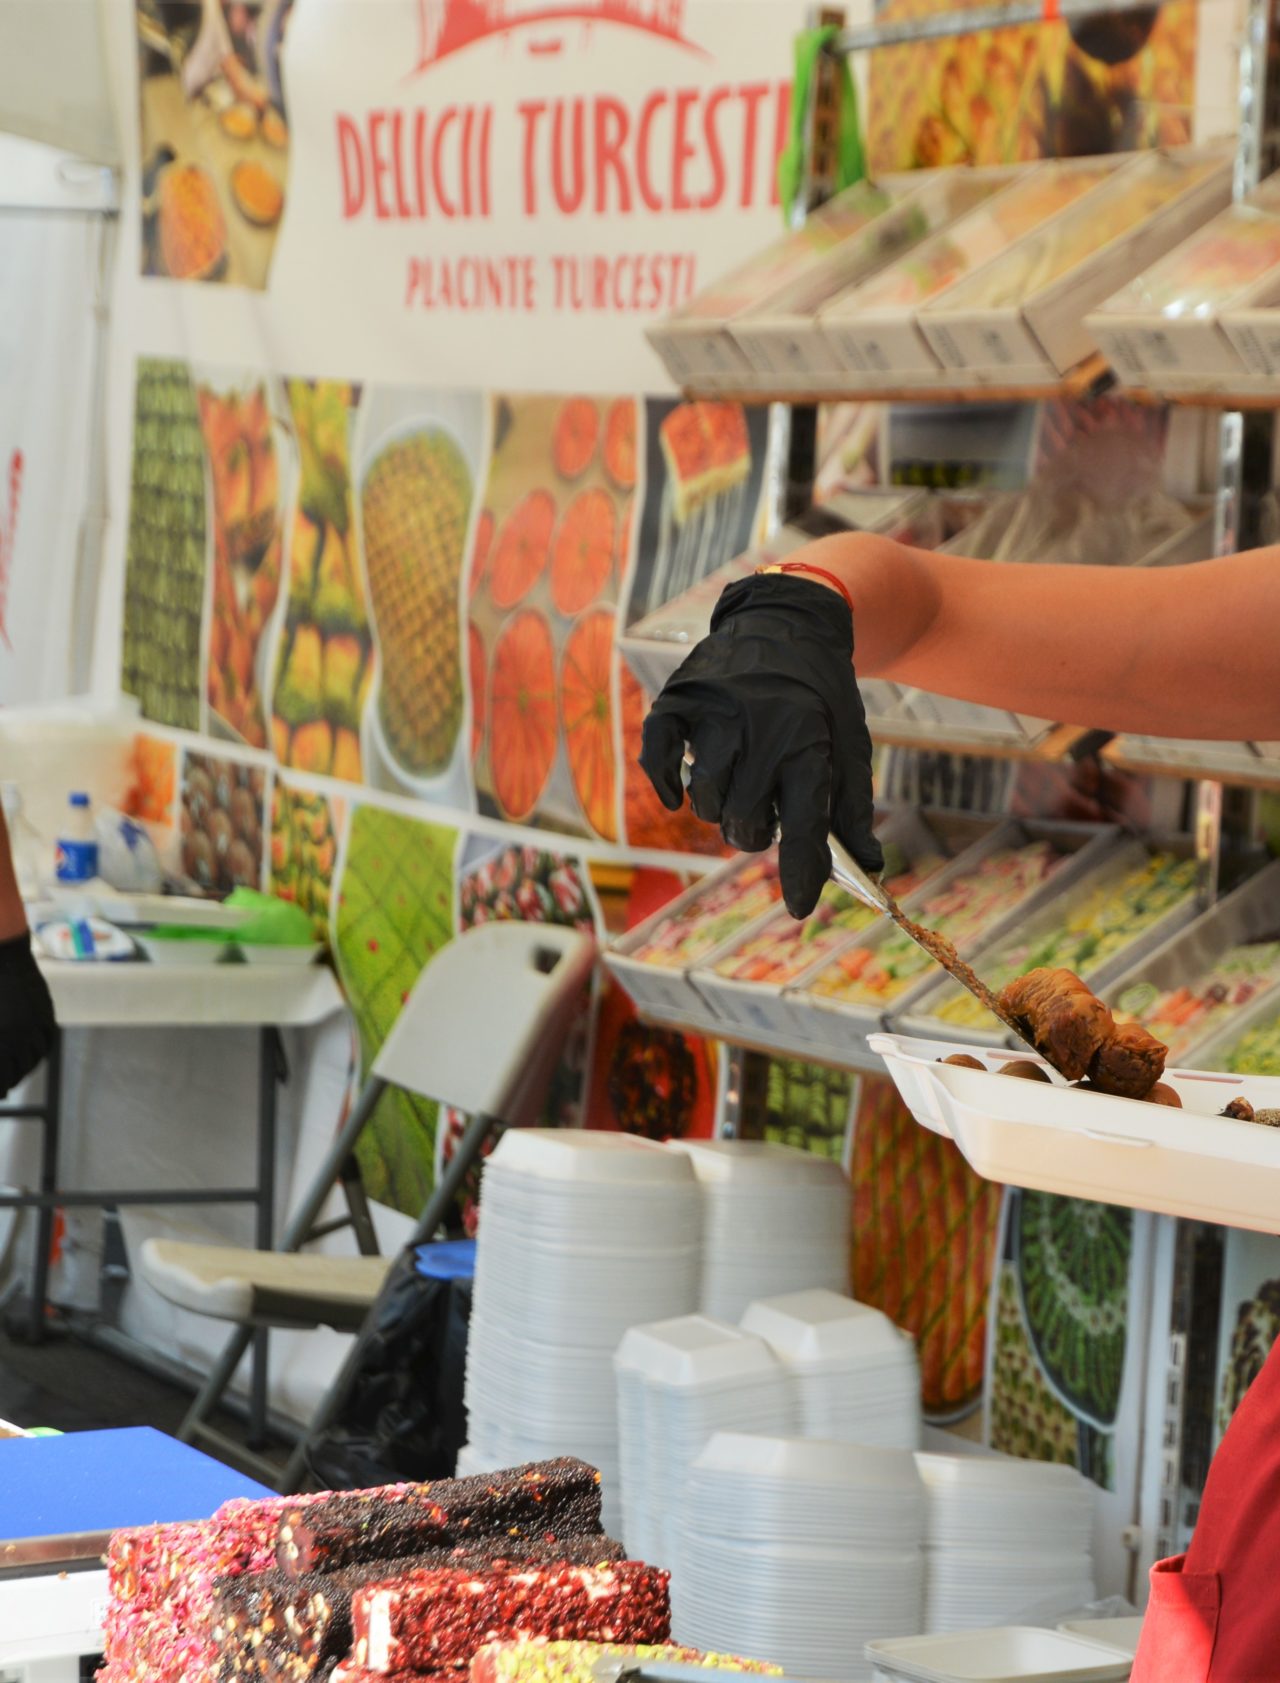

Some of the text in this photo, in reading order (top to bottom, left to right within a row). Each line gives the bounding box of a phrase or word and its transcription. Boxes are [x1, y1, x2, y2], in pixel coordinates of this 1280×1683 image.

[336, 79, 793, 220] DELICII TURCESTI
[405, 254, 536, 311] PLACINTE
